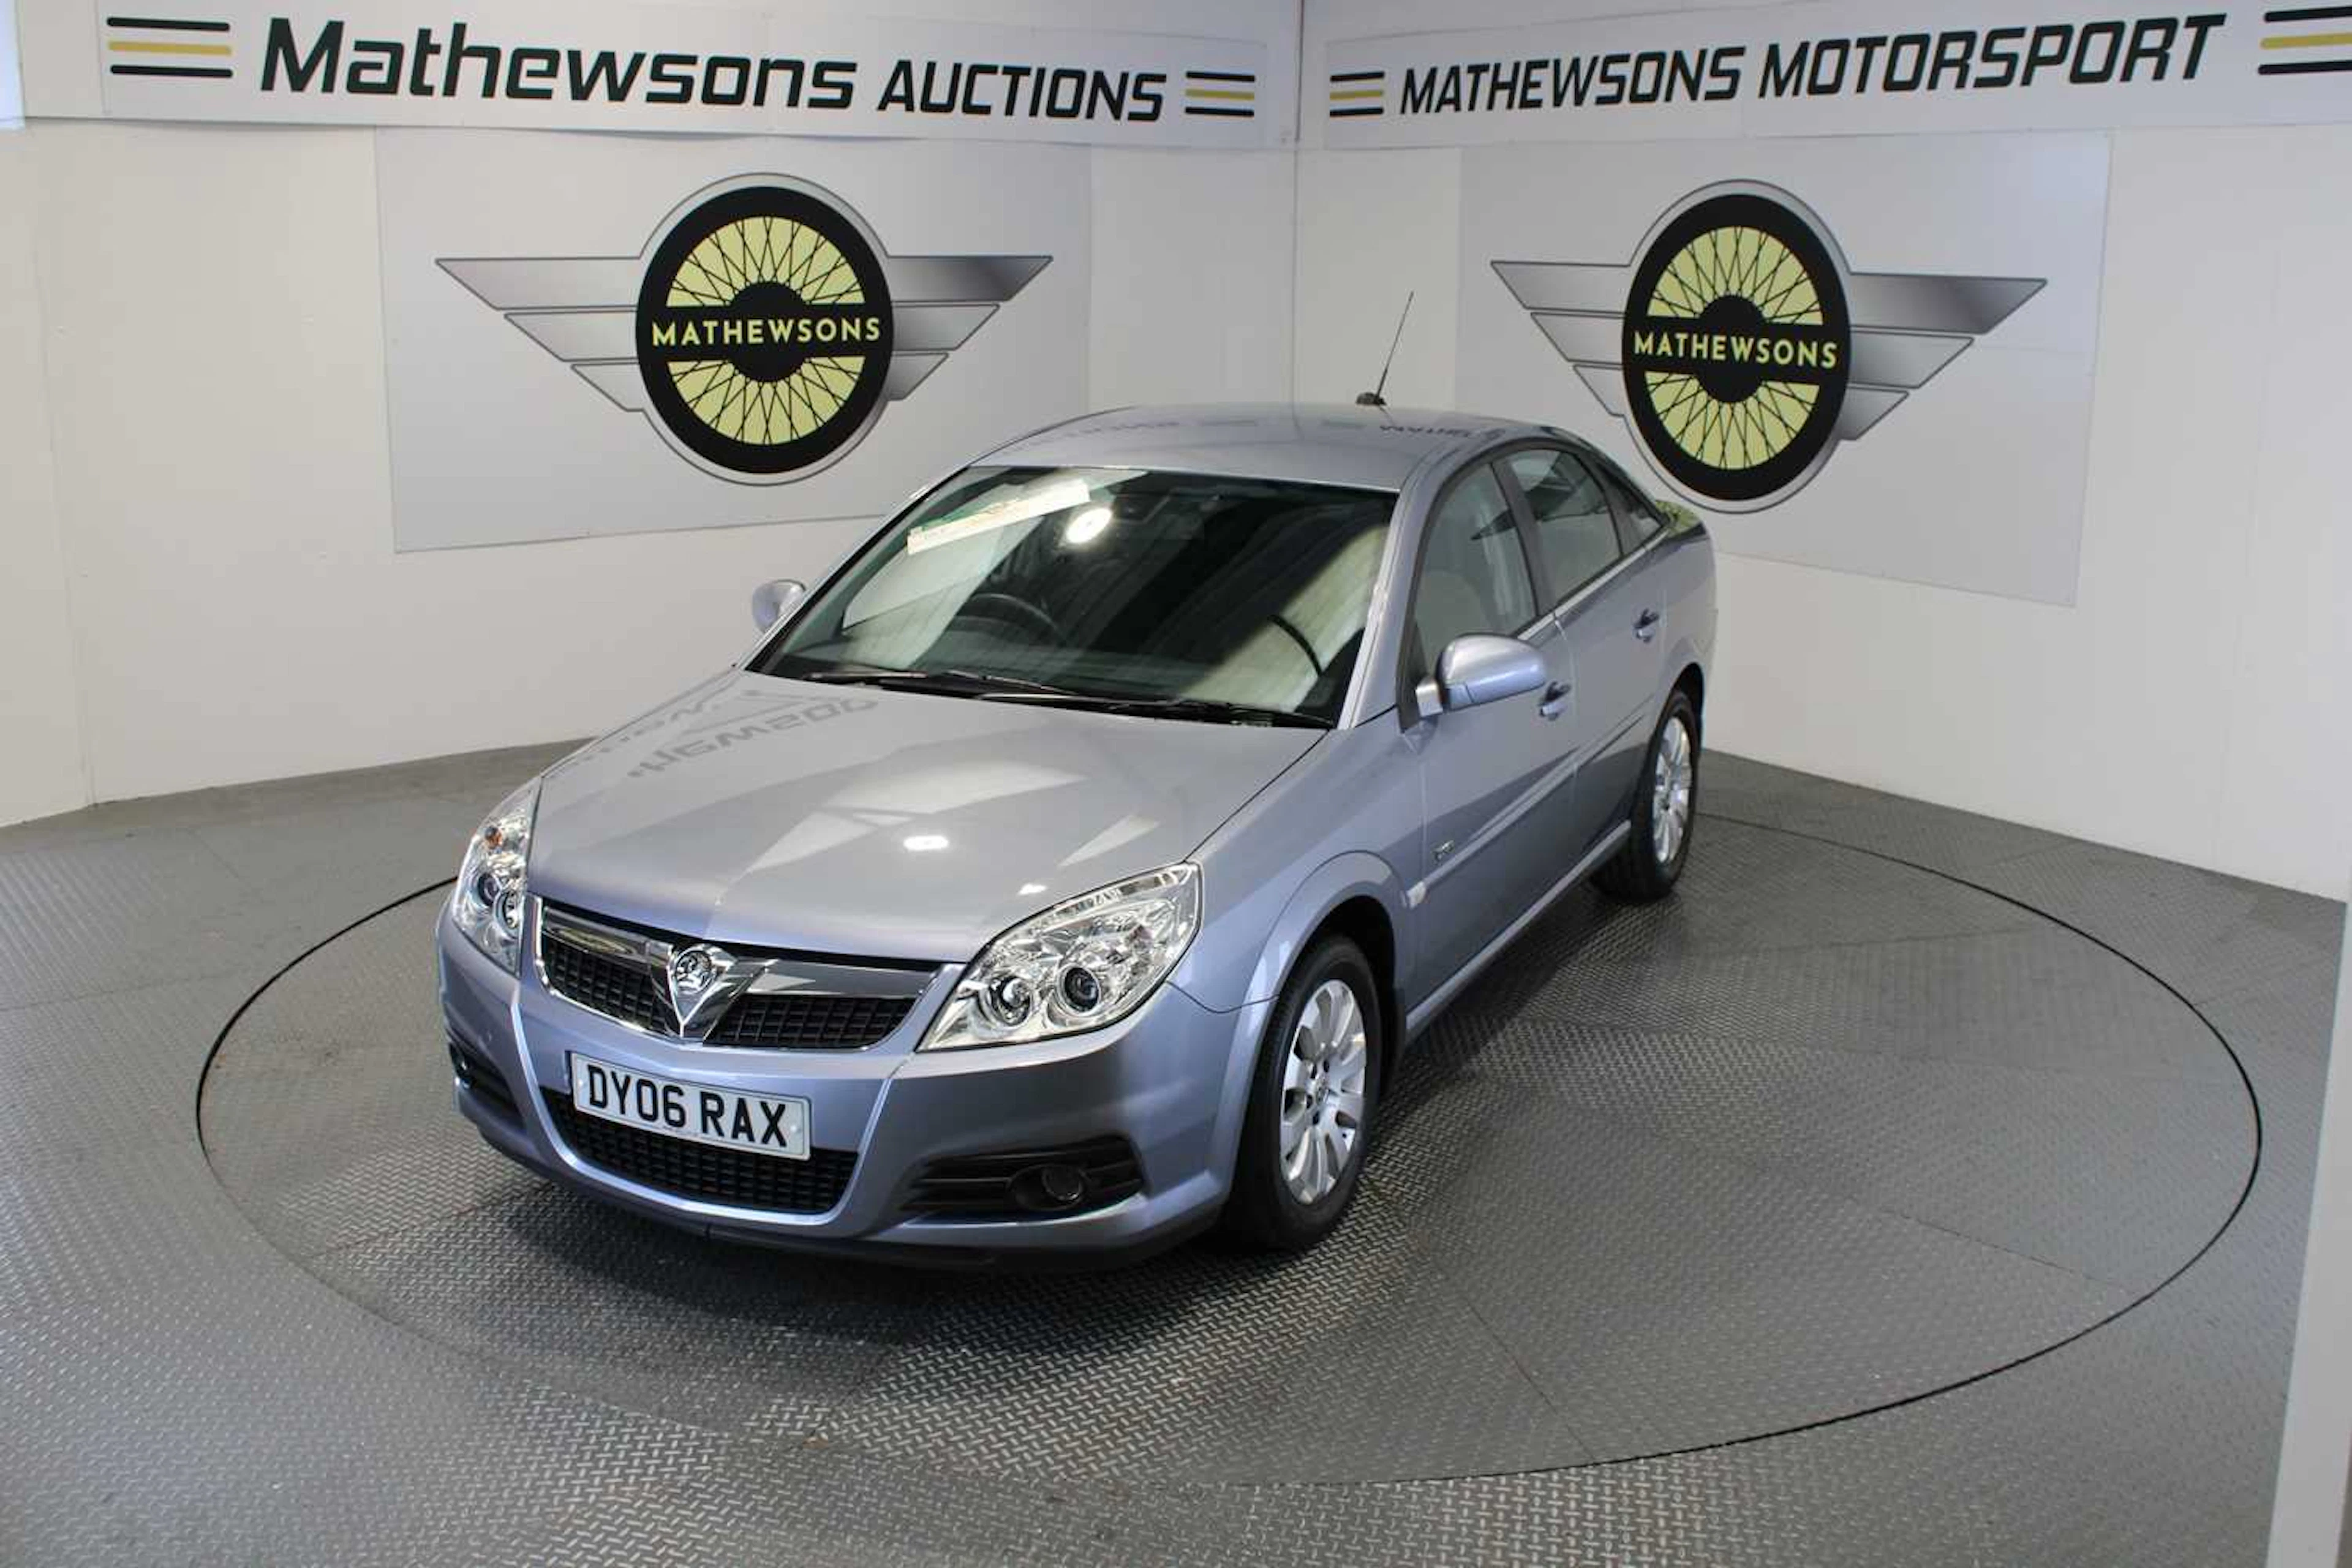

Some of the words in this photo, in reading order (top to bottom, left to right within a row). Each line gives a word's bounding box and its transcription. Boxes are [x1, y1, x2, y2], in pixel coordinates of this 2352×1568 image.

[260, 17, 858, 110] Mathewsons
[877, 59, 1167, 122] AUCTIONS
[1400, 46, 1746, 115] MATHEWSONS
[1758, 13, 2227, 99] MOTORSPORT
[652, 317, 880, 347] MATHEWSONS
[1634, 331, 1838, 369] MATHEWSONS
[587, 1064, 686, 1128] DY06
[699, 1091, 788, 1148] RAX
